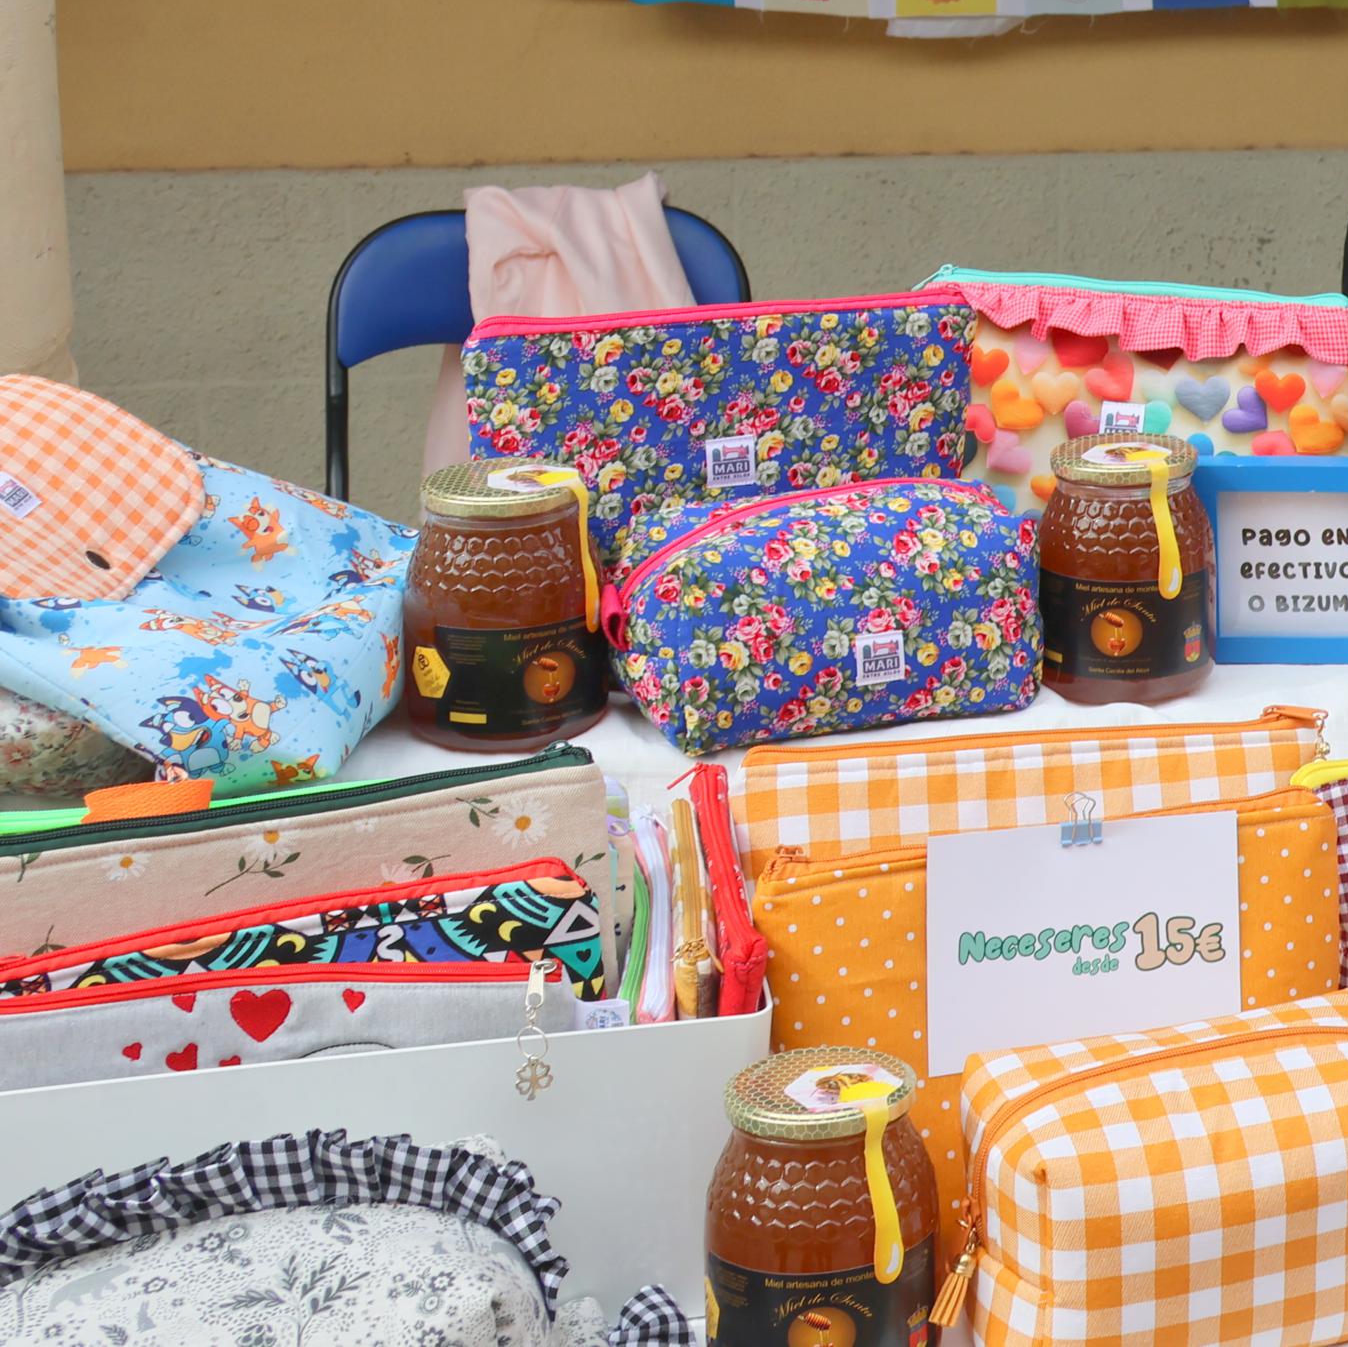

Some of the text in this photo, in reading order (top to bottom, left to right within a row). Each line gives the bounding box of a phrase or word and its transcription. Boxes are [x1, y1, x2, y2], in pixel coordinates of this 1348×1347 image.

[713, 462, 750, 474] MARI
[864, 659, 899, 672] MARI
[958, 911, 1226, 971] Neceseres 15€
[1072, 953, 1120, 976] desde
[764, 1278, 785, 1289] Miel
[785, 1280, 829, 1290] artesana
[830, 1277, 844, 1287] de
